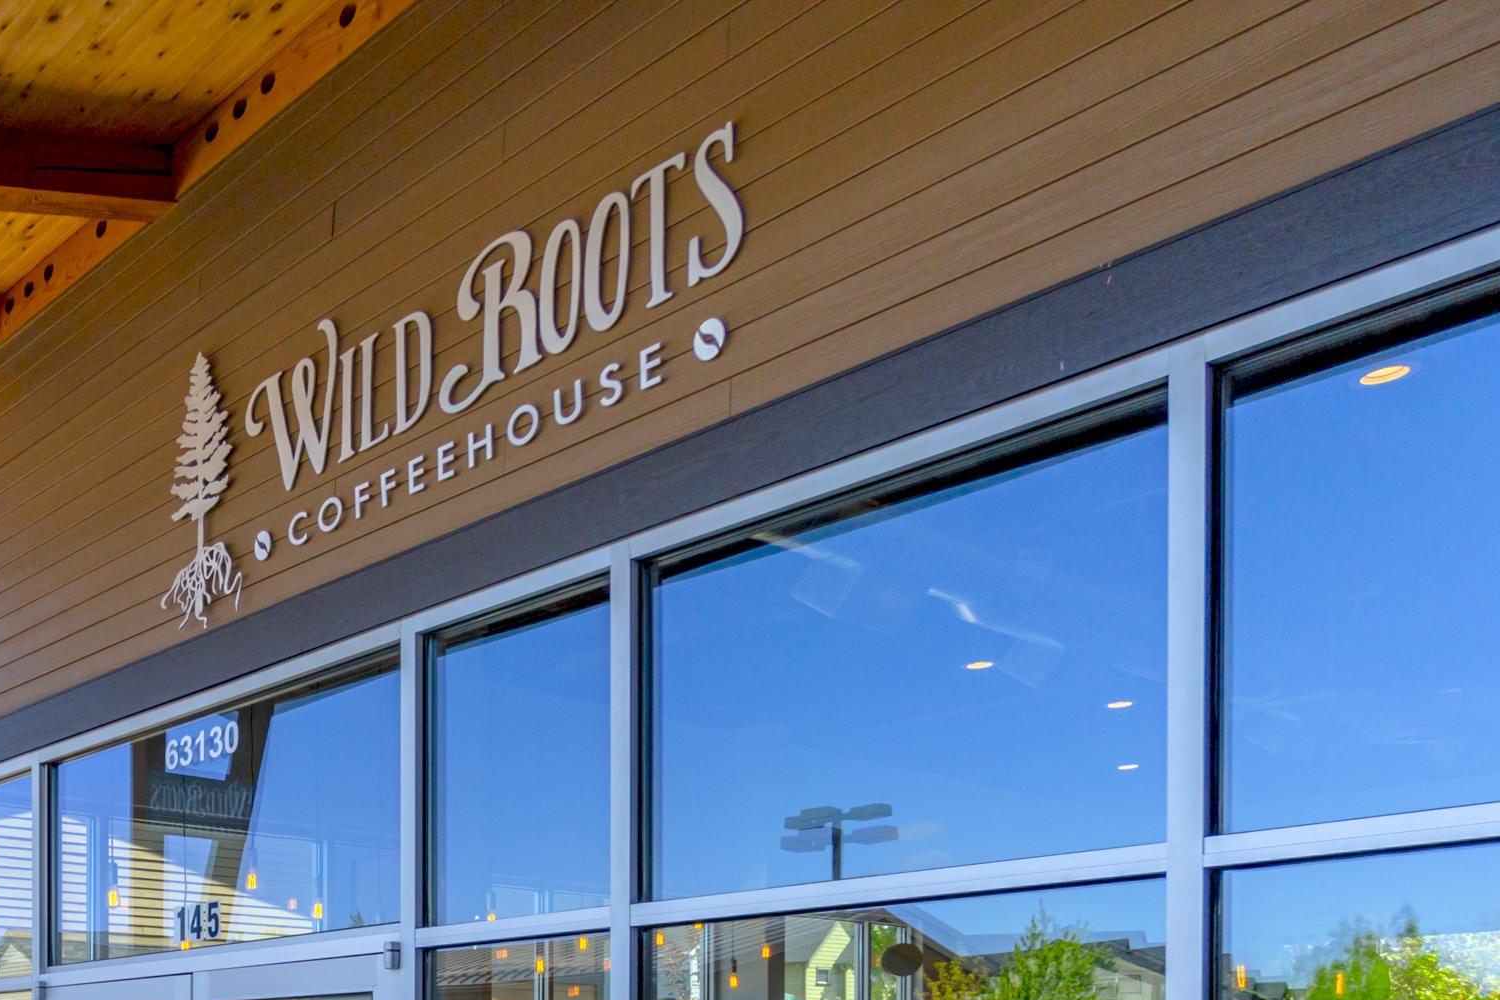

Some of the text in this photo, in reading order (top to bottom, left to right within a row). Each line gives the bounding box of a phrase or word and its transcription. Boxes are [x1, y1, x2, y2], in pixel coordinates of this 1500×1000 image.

[245, 120, 745, 492] WILD ROOTS
[287, 341, 664, 546] COFFEEHOUSE
[165, 720, 239, 770] 63130
[177, 901, 219, 941] 145
